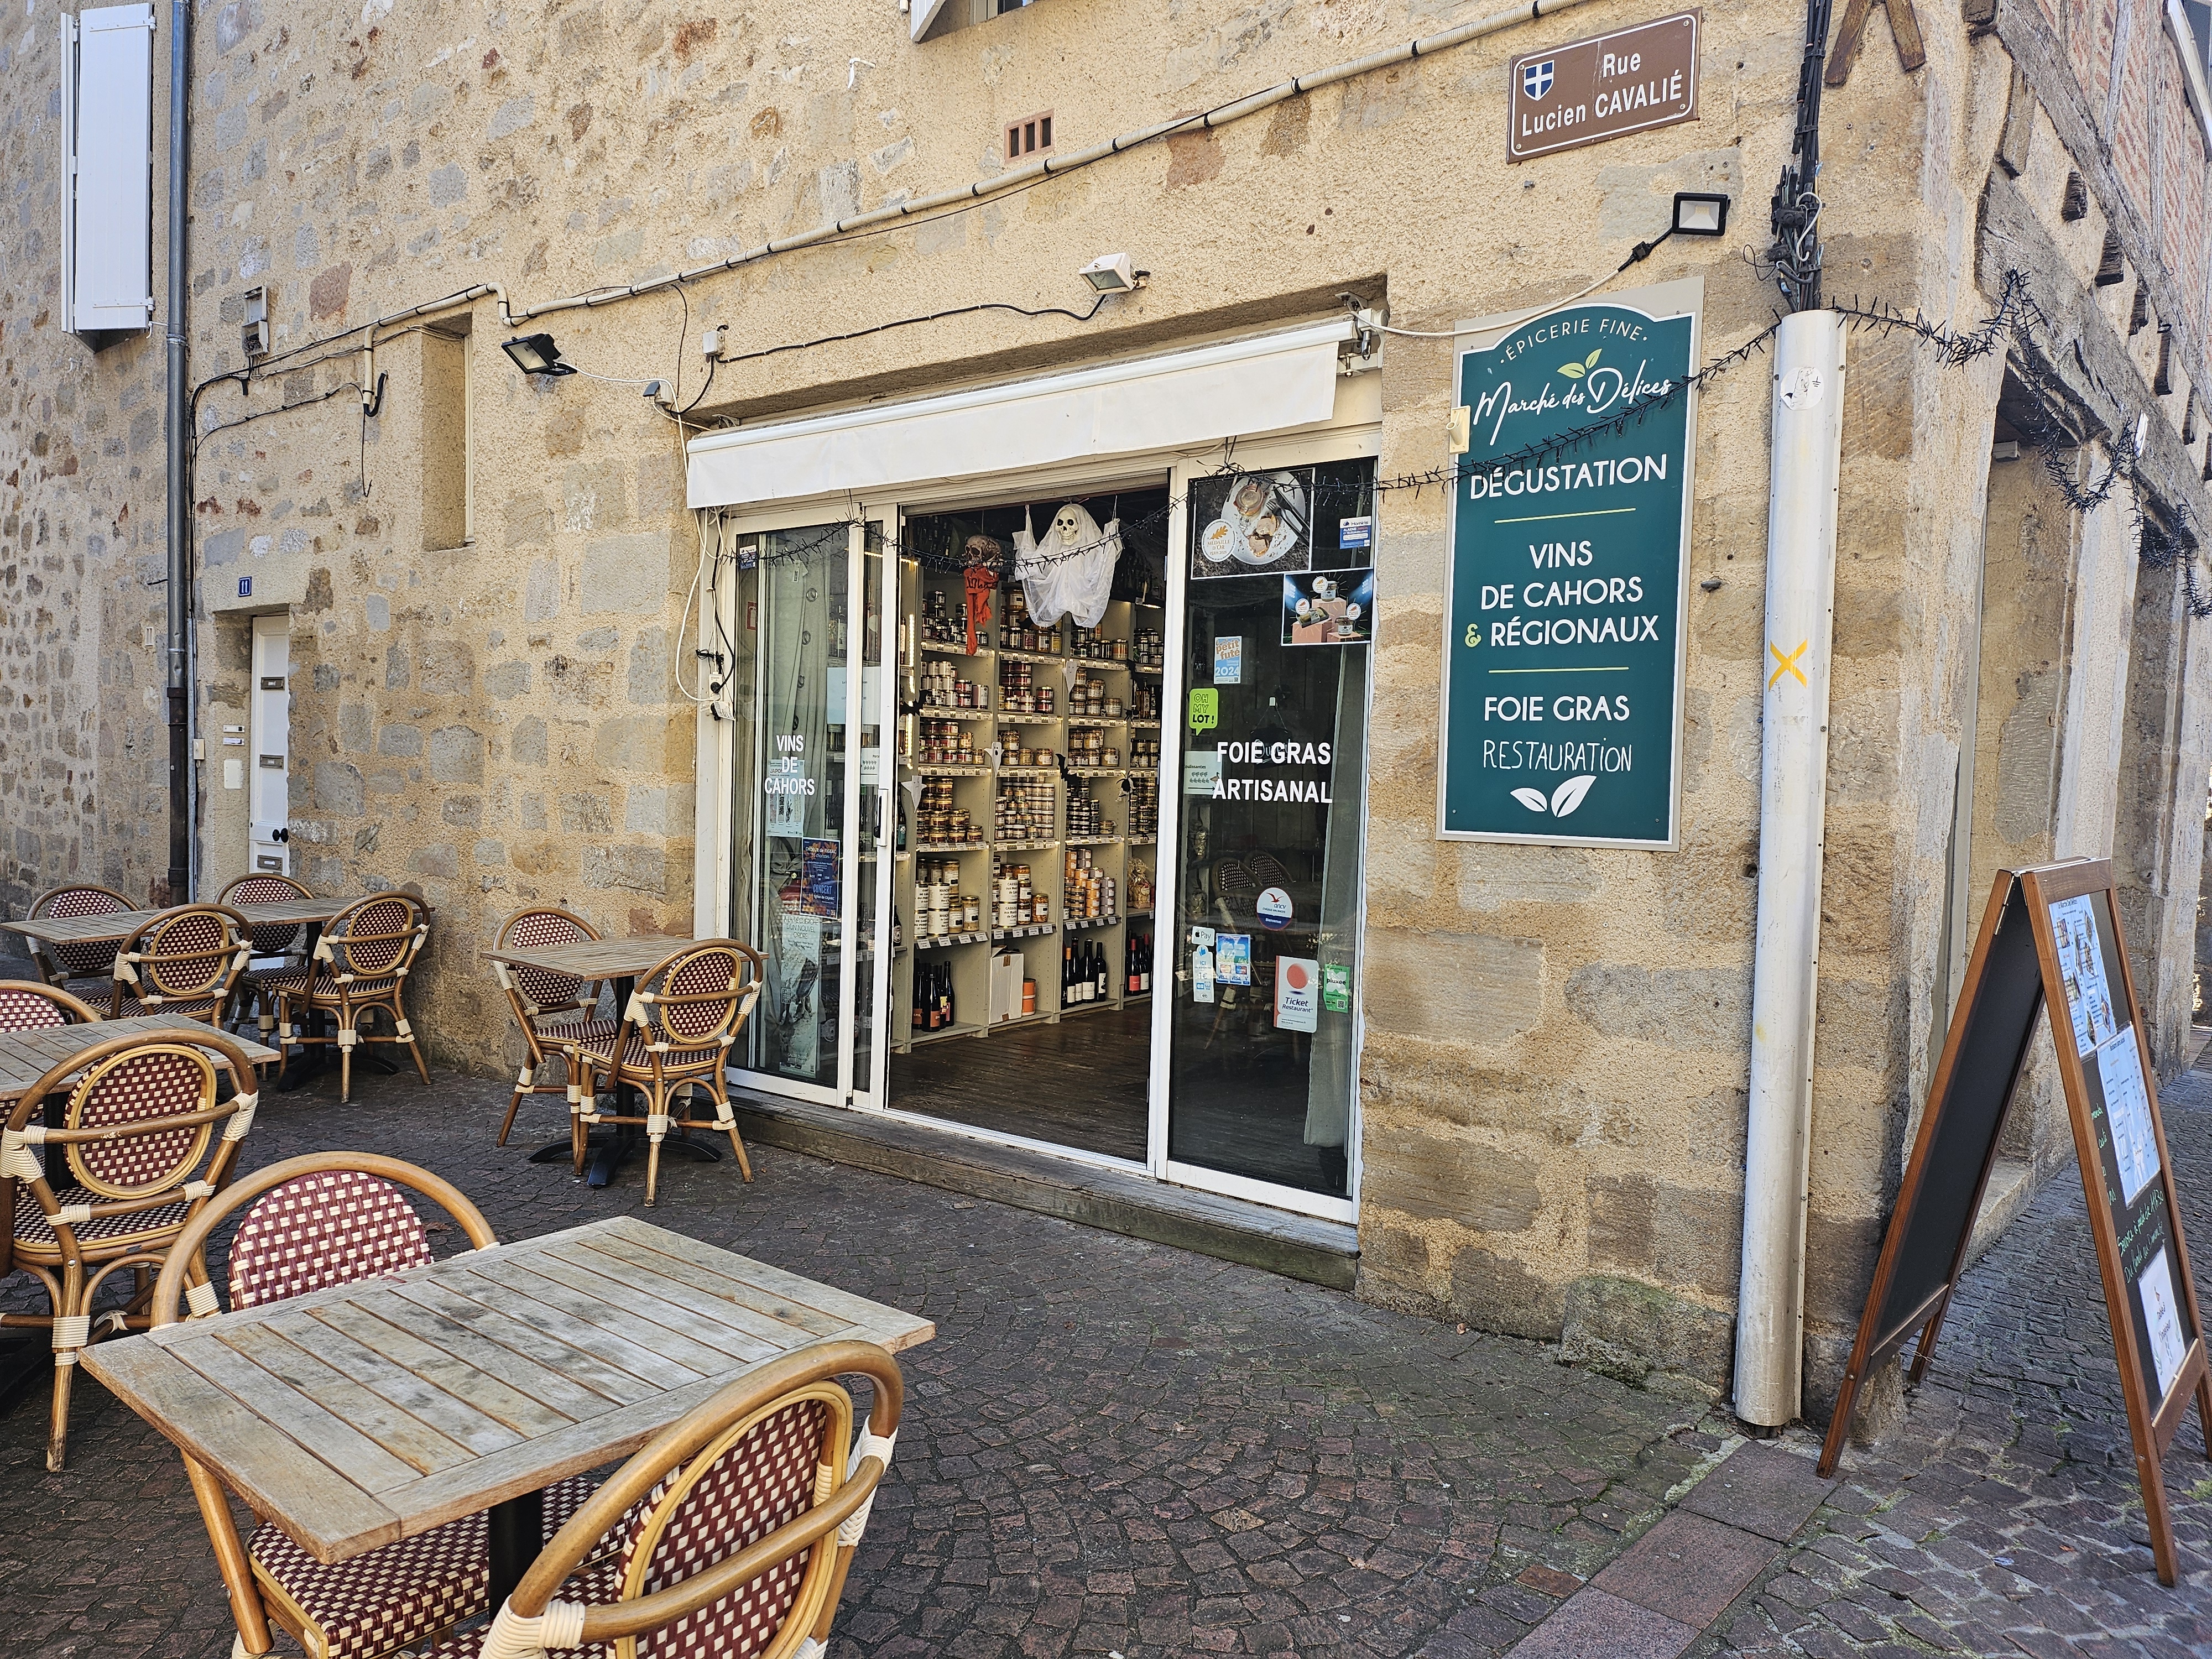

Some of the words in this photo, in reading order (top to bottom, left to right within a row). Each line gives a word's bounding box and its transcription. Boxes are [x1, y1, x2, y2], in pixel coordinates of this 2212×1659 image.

[1603, 52, 1641, 78] Rue
[1521, 104, 1586, 137] Lucien
[1595, 69, 1682, 118] CAVALIÉ
[1505, 319, 1590, 361] ÉPICERIE
[1599, 318, 1643, 341] FINE
[1473, 382, 1561, 446] Marché
[1562, 383, 1585, 409] des
[1587, 359, 1672, 414] Délices
[1470, 453, 1667, 499] DÉGUSTATION
[1529, 540, 1593, 568] VINS
[241, 581, 249, 593] 11
[1481, 585, 1514, 610] DE
[1523, 576, 1644, 608] CAHORS
[1464, 623, 1481, 648] &
[1491, 615, 1659, 646] RÉGIONAUX
[1216, 639, 1239, 654] petit
[1220, 648, 1240, 660] futé
[1215, 666, 1239, 676] 2024
[1193, 693, 1208, 703] OH
[1193, 704, 1209, 713] MY
[1484, 697, 1543, 721] FOIE
[1553, 695, 1630, 721] GRAS
[776, 734, 804, 752] VINS
[1217, 742, 1263, 763] FOIE
[1271, 742, 1331, 764] GRAS
[782, 756, 797, 773] DE
[764, 778, 815, 795] CAHORS
[1212, 779, 1333, 804] ARTISANAL
[813, 884, 832, 894] CONCERT
[1201, 931, 1211, 941] Pay
[1285, 997, 1308, 1007] Ticket
